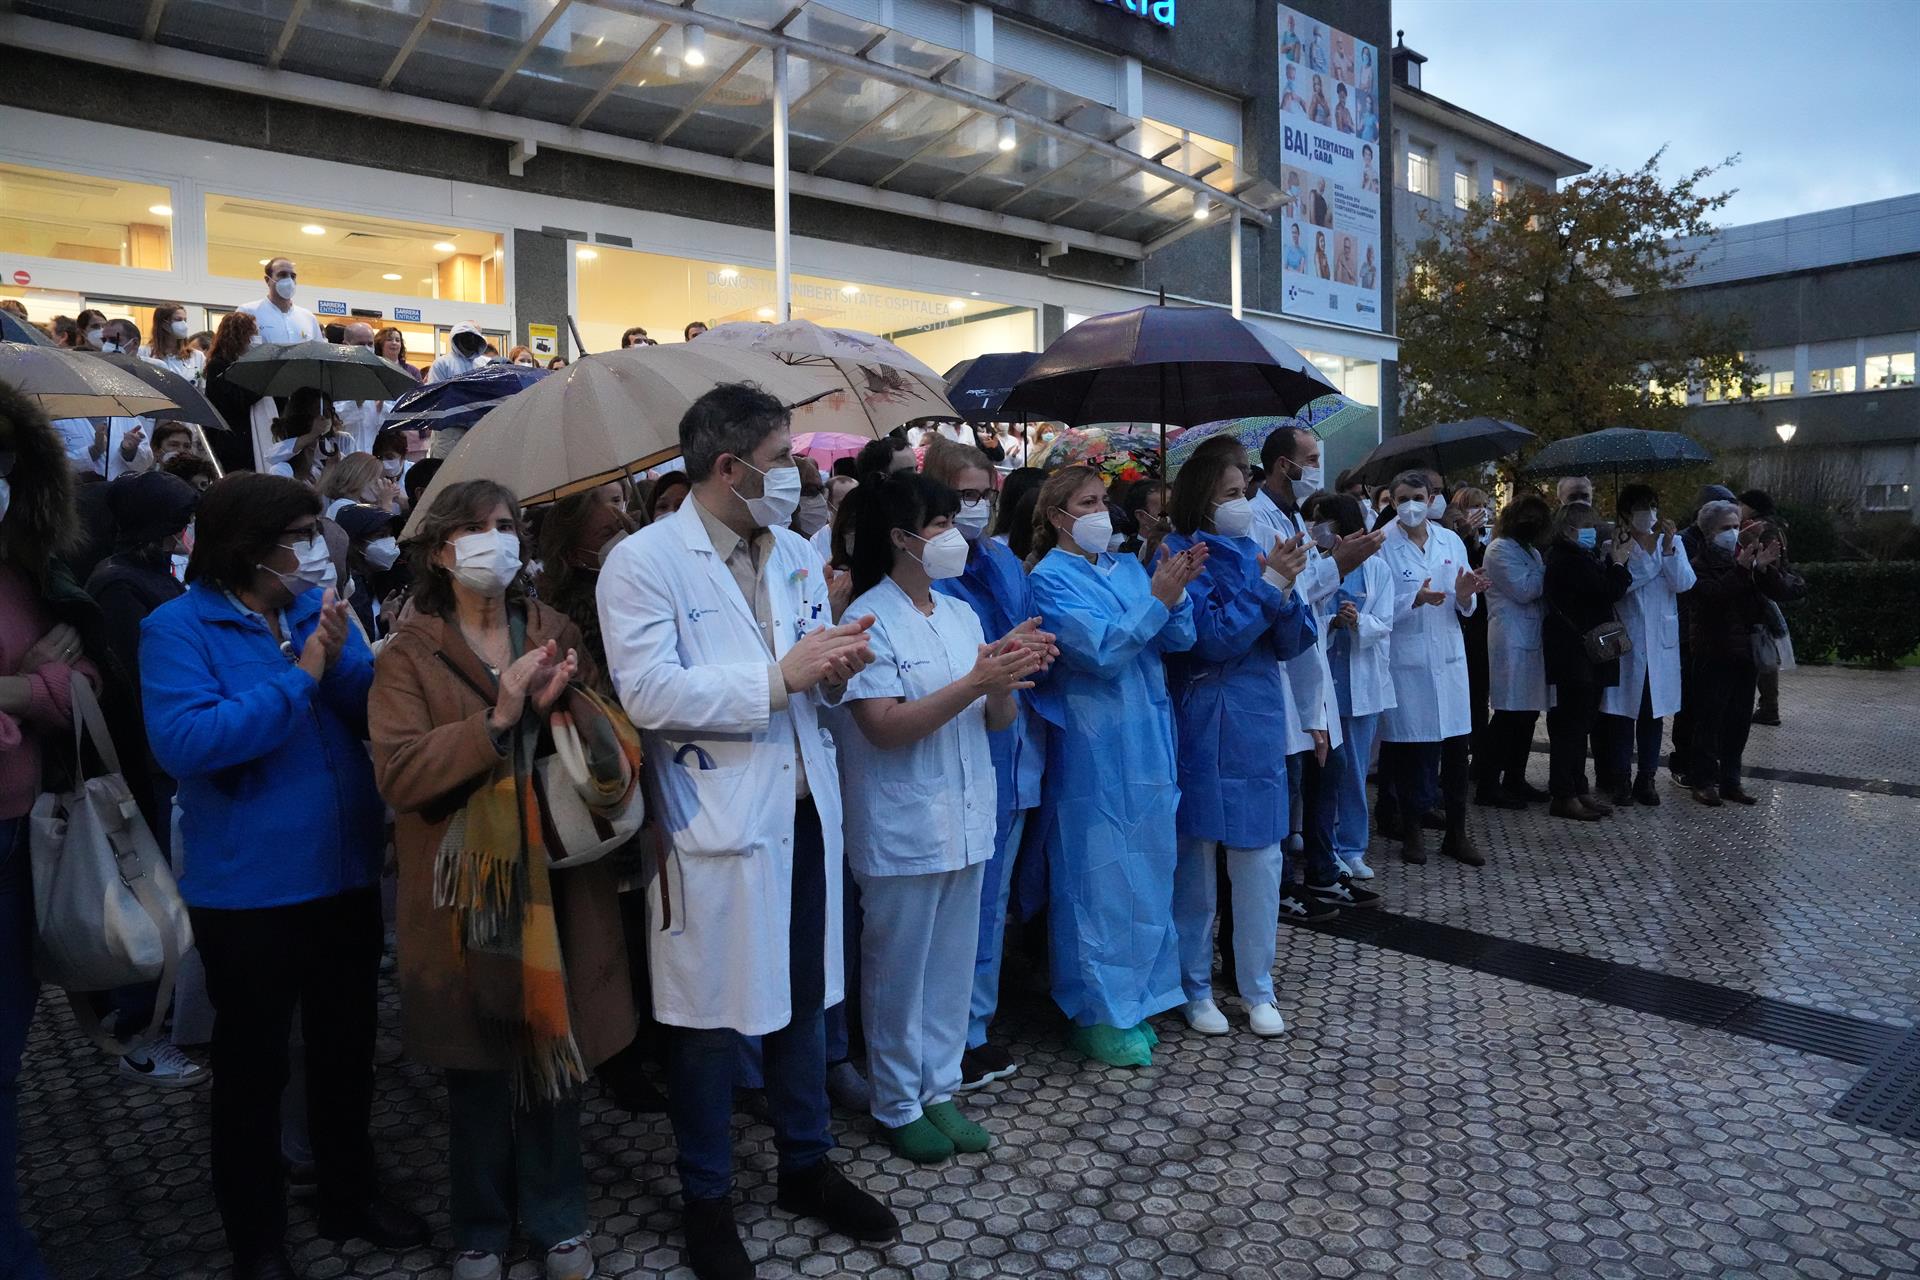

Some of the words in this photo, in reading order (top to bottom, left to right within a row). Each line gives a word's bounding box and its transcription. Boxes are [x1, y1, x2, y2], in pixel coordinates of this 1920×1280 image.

[1284, 125, 1312, 160] BAI,
[1313, 136, 1354, 160] TXERTATZEN
[1313, 149, 1333, 165] GARA
[319, 301, 345, 309] SARRERA
[790, 282, 882, 307] NIBERTSITATE
[885, 295, 950, 316] OSPITALEA
[395, 308, 420, 316] SARRERA
